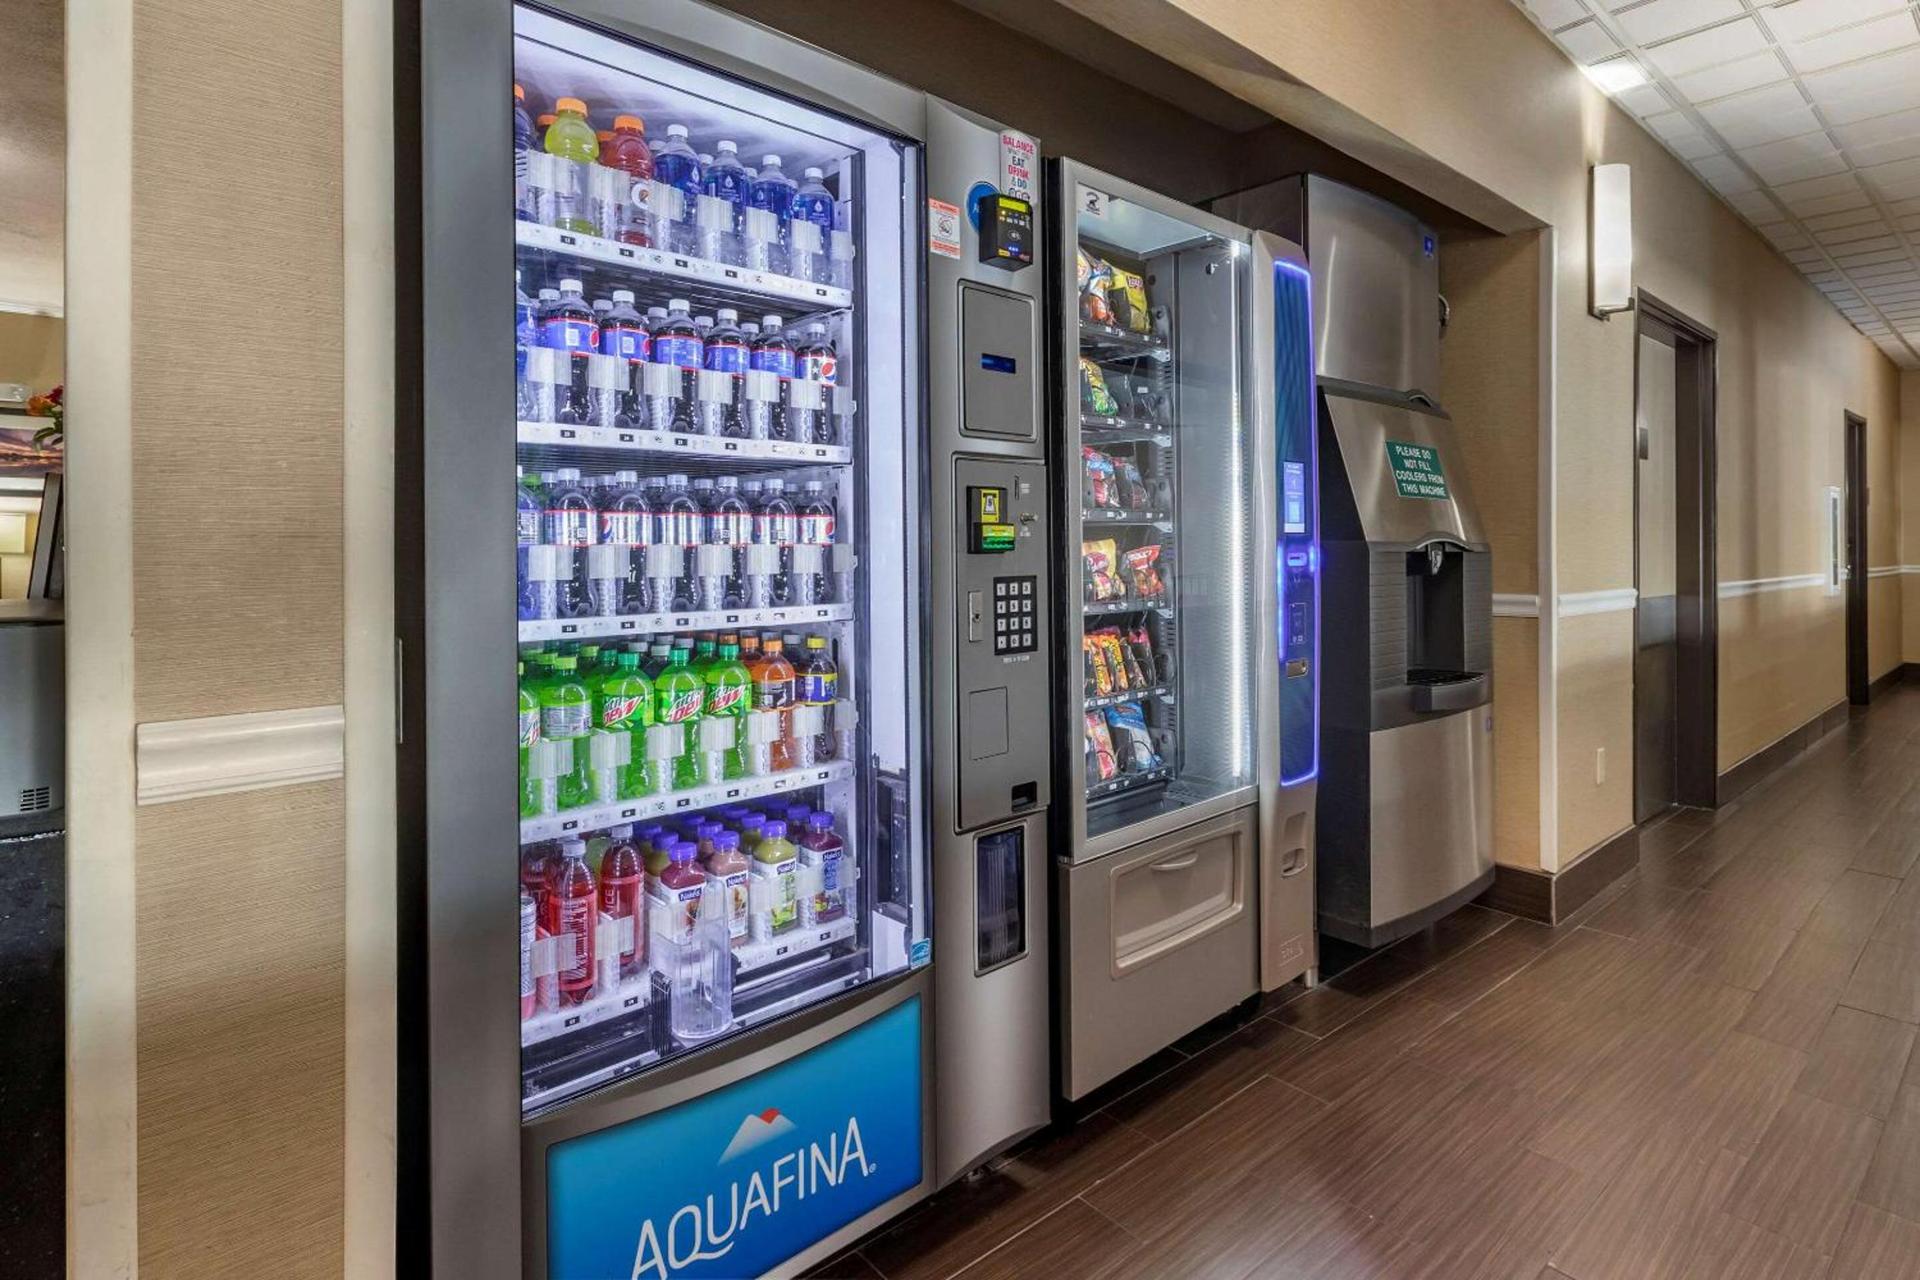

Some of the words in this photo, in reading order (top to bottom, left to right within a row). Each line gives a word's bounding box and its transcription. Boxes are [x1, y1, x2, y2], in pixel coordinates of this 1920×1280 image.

[1002, 134, 1034, 155] BALANCE
[1012, 156, 1025, 168] EAT
[1007, 164, 1029, 180] DRINK
[1395, 446, 1421, 458] PLEASE
[1421, 450, 1431, 460] DO
[1403, 459, 1417, 469] NOT
[1418, 460, 1431, 471] FILL
[1401, 483, 1418, 494] THIS
[631, 1116, 869, 1280] AQUAFINA
